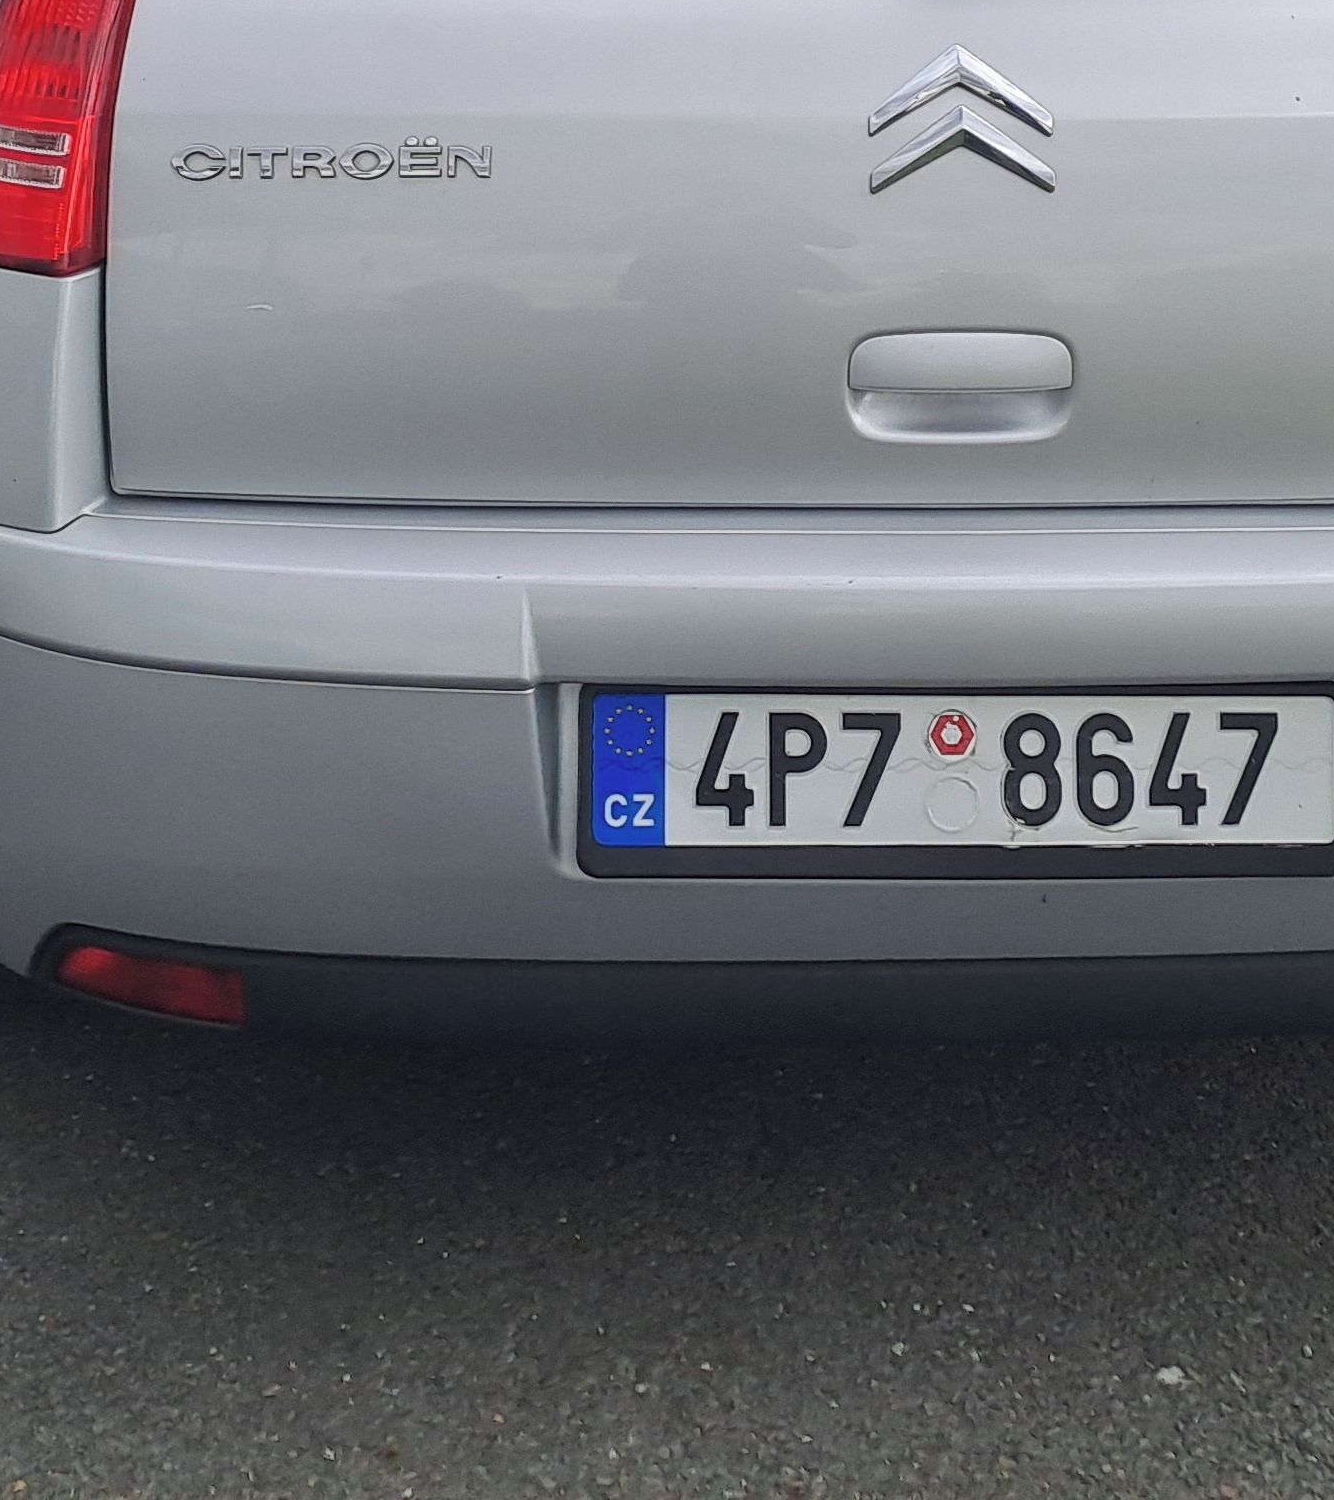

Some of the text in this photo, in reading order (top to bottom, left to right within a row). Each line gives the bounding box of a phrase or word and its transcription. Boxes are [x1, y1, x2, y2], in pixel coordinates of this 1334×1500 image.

[170, 135, 492, 181] CITROËN
[695, 711, 1281, 828] 4P7 8647
[604, 793, 655, 827] CZ
